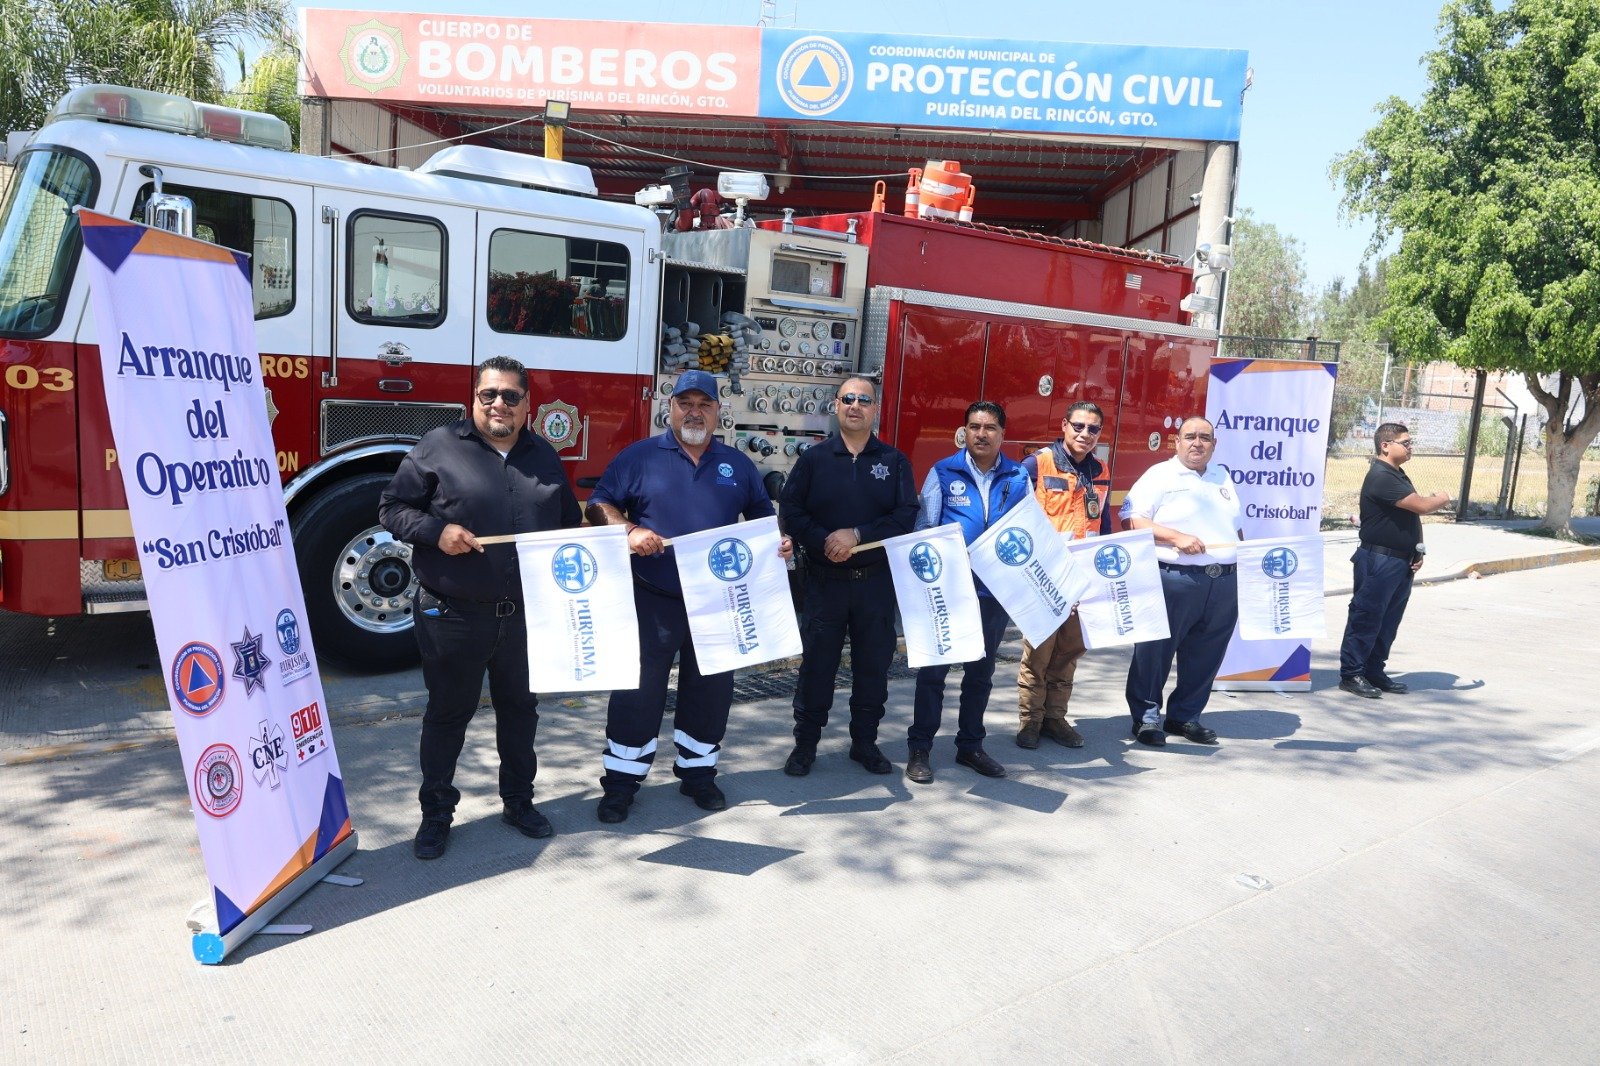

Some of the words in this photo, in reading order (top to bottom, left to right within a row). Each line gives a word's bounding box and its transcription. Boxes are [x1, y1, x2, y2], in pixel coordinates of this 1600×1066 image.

[418, 19, 500, 40] CUERPO
[506, 24, 532, 41] DE
[418, 40, 738, 91] BOMBEROS
[869, 44, 964, 61] COORDINACIÓN
[968, 48, 1036, 64] MUNICIPAL
[1038, 52, 1056, 64] DE
[418, 83, 514, 99] VOLUNTARIOS
[517, 88, 536, 100] DE
[540, 86, 604, 103] PURÍSIMA
[607, 92, 634, 105] DEL
[637, 90, 694, 108] RINCÓN,
[697, 95, 729, 109] GTO.
[866, 62, 1112, 103] PROTECCIÓN
[1122, 75, 1223, 108] CIVIL
[926, 100, 1006, 120] PURÍSIMA
[1010, 104, 1042, 120] DEL
[1046, 105, 1116, 126] RINCÓN,
[1120, 112, 1158, 126] GTO.
[5, 365, 74, 391] 03
[117, 332, 253, 392] Arranque
[186, 398, 228, 438] del
[1215, 409, 1320, 437] Arranque
[1251, 440, 1282, 460] del
[136, 449, 270, 505] Operativo
[1218, 464, 1315, 486] perativo
[1030, 559, 1068, 612] PURÍSIMA
[735, 583, 760, 651] PURÍSIMA
[932, 586, 952, 652] PURÍSIMA
[292, 704, 320, 736] 911
[253, 737, 284, 769] CNE
[296, 729, 324, 750] EMERGENCIAS
